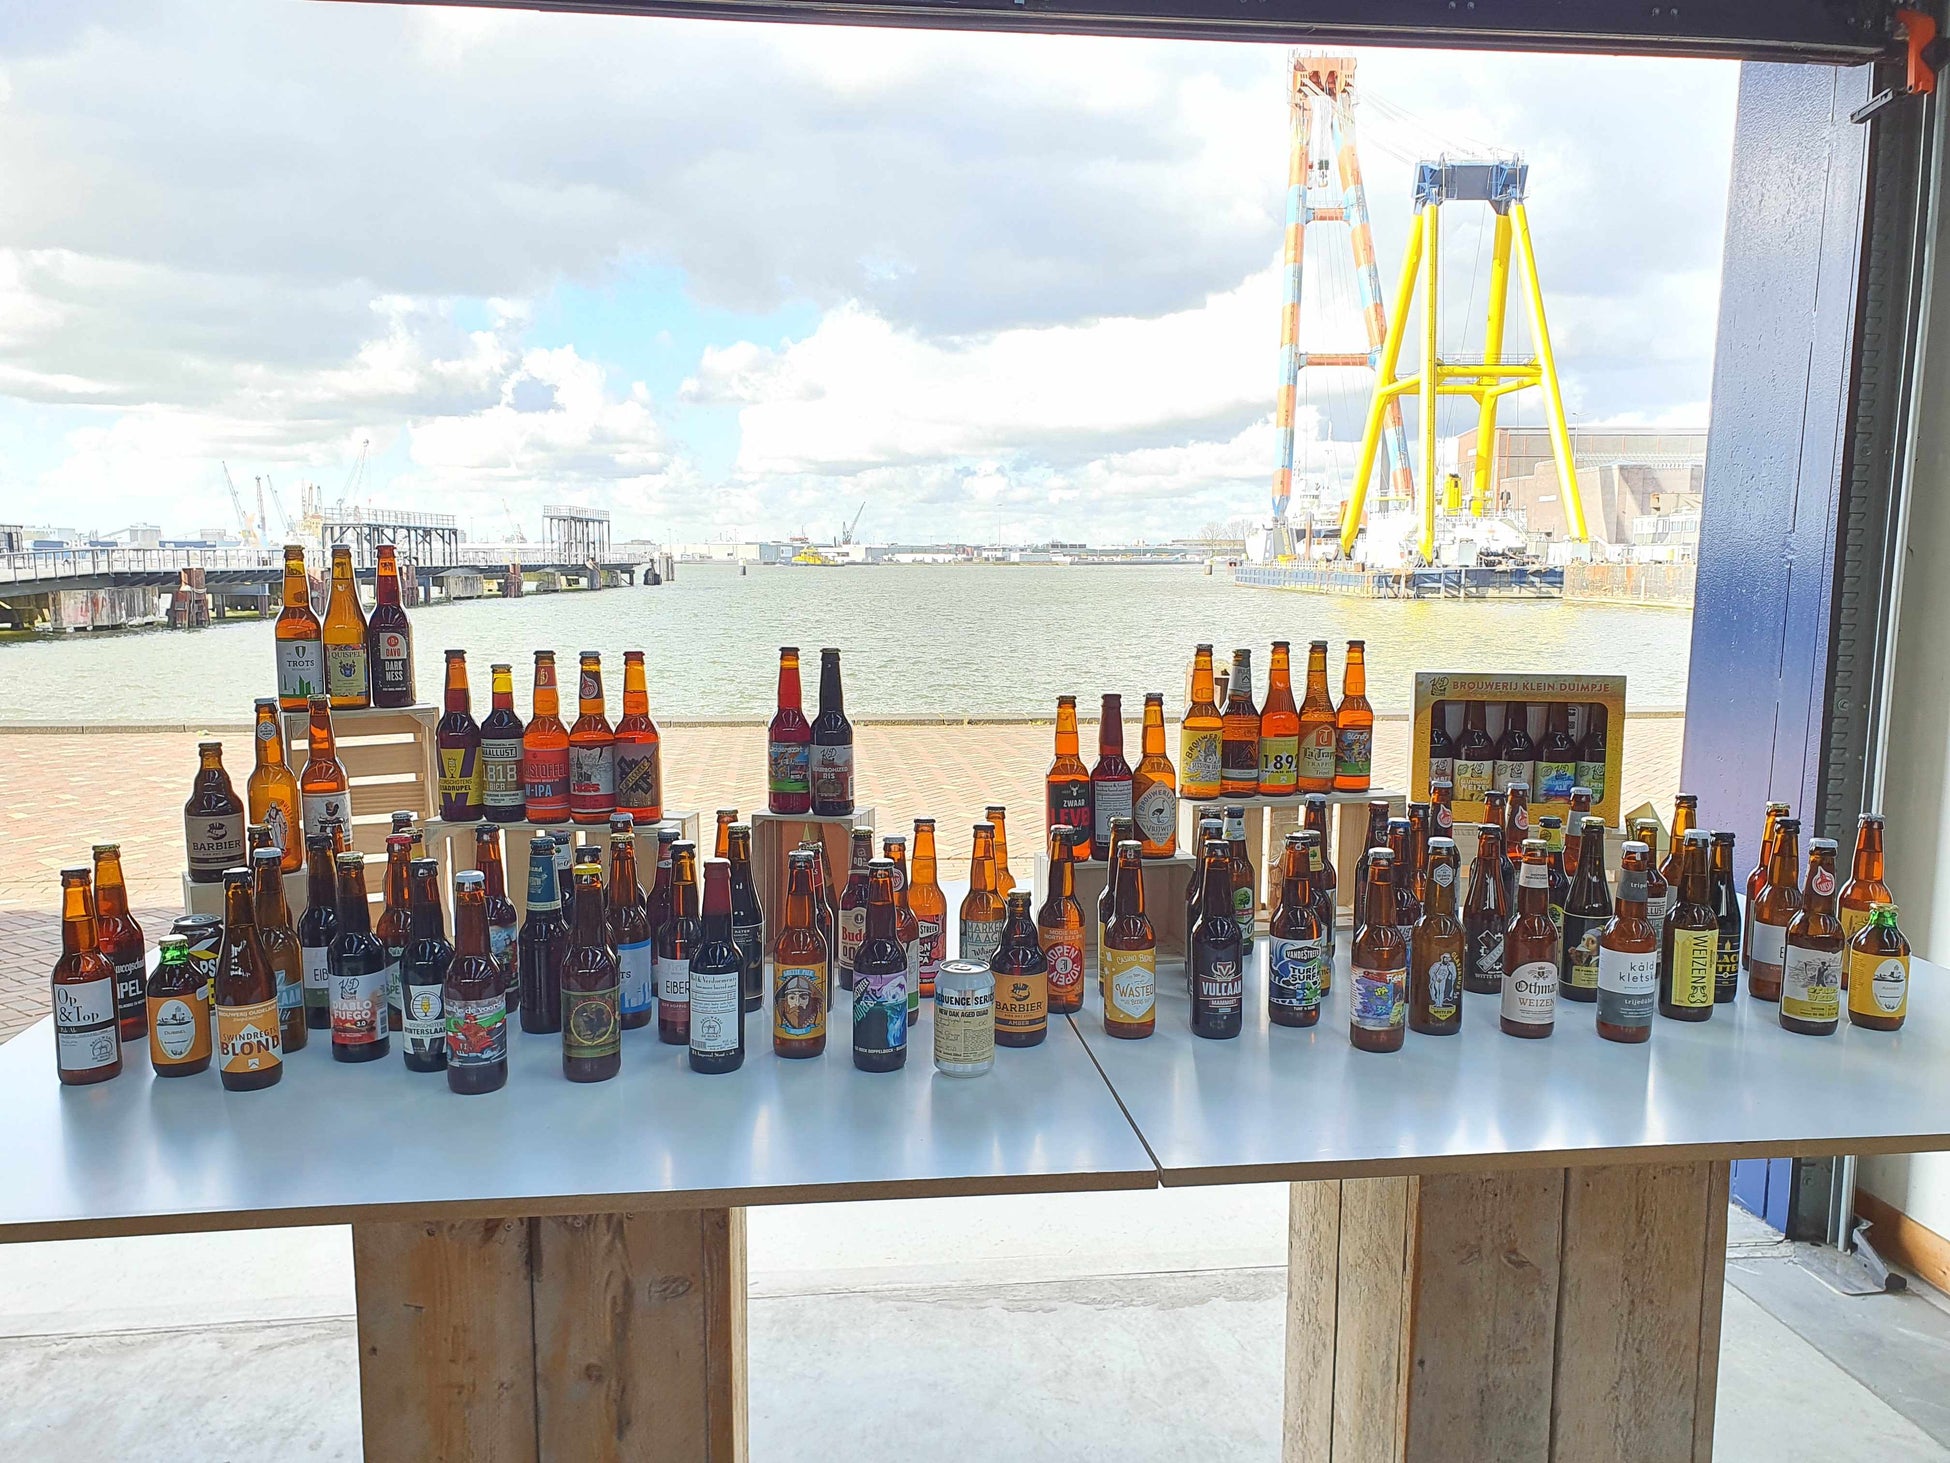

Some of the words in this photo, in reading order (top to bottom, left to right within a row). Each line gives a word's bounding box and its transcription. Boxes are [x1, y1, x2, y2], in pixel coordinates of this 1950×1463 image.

[331, 651, 362, 659] QUISPEL
[286, 659, 315, 668] TROTS
[385, 661, 403, 671] DARK
[385, 671, 403, 681] NESS
[1453, 682, 1519, 692] BROUWERIJ
[1522, 682, 1555, 692] KLEIN
[1559, 682, 1610, 693] DUIMPJE
[483, 764, 517, 782] 1818
[489, 782, 506, 791] BIER
[1063, 799, 1085, 808] ZWAAR
[192, 839, 241, 851] BARBIER
[919, 924, 937, 934] STREEK
[1047, 945, 1078, 965] JOPEN
[1116, 955, 1137, 965] CASINO
[1691, 935, 1709, 985] WEIZEN
[313, 968, 329, 982] EIB
[1049, 964, 1080, 986] JOPEN
[1290, 965, 1317, 975] TURF
[1115, 983, 1154, 998] WASTED
[57, 987, 77, 1007] Op
[333, 1000, 372, 1011] DIABLO
[995, 1000, 1043, 1013] BARBIER
[334, 1010, 372, 1020] FUEGO
[948, 1009, 960, 1017] OAK
[960, 1009, 976, 1018] AGED
[222, 1027, 277, 1042] SWINDREGTS
[221, 1034, 280, 1057] BLOND
